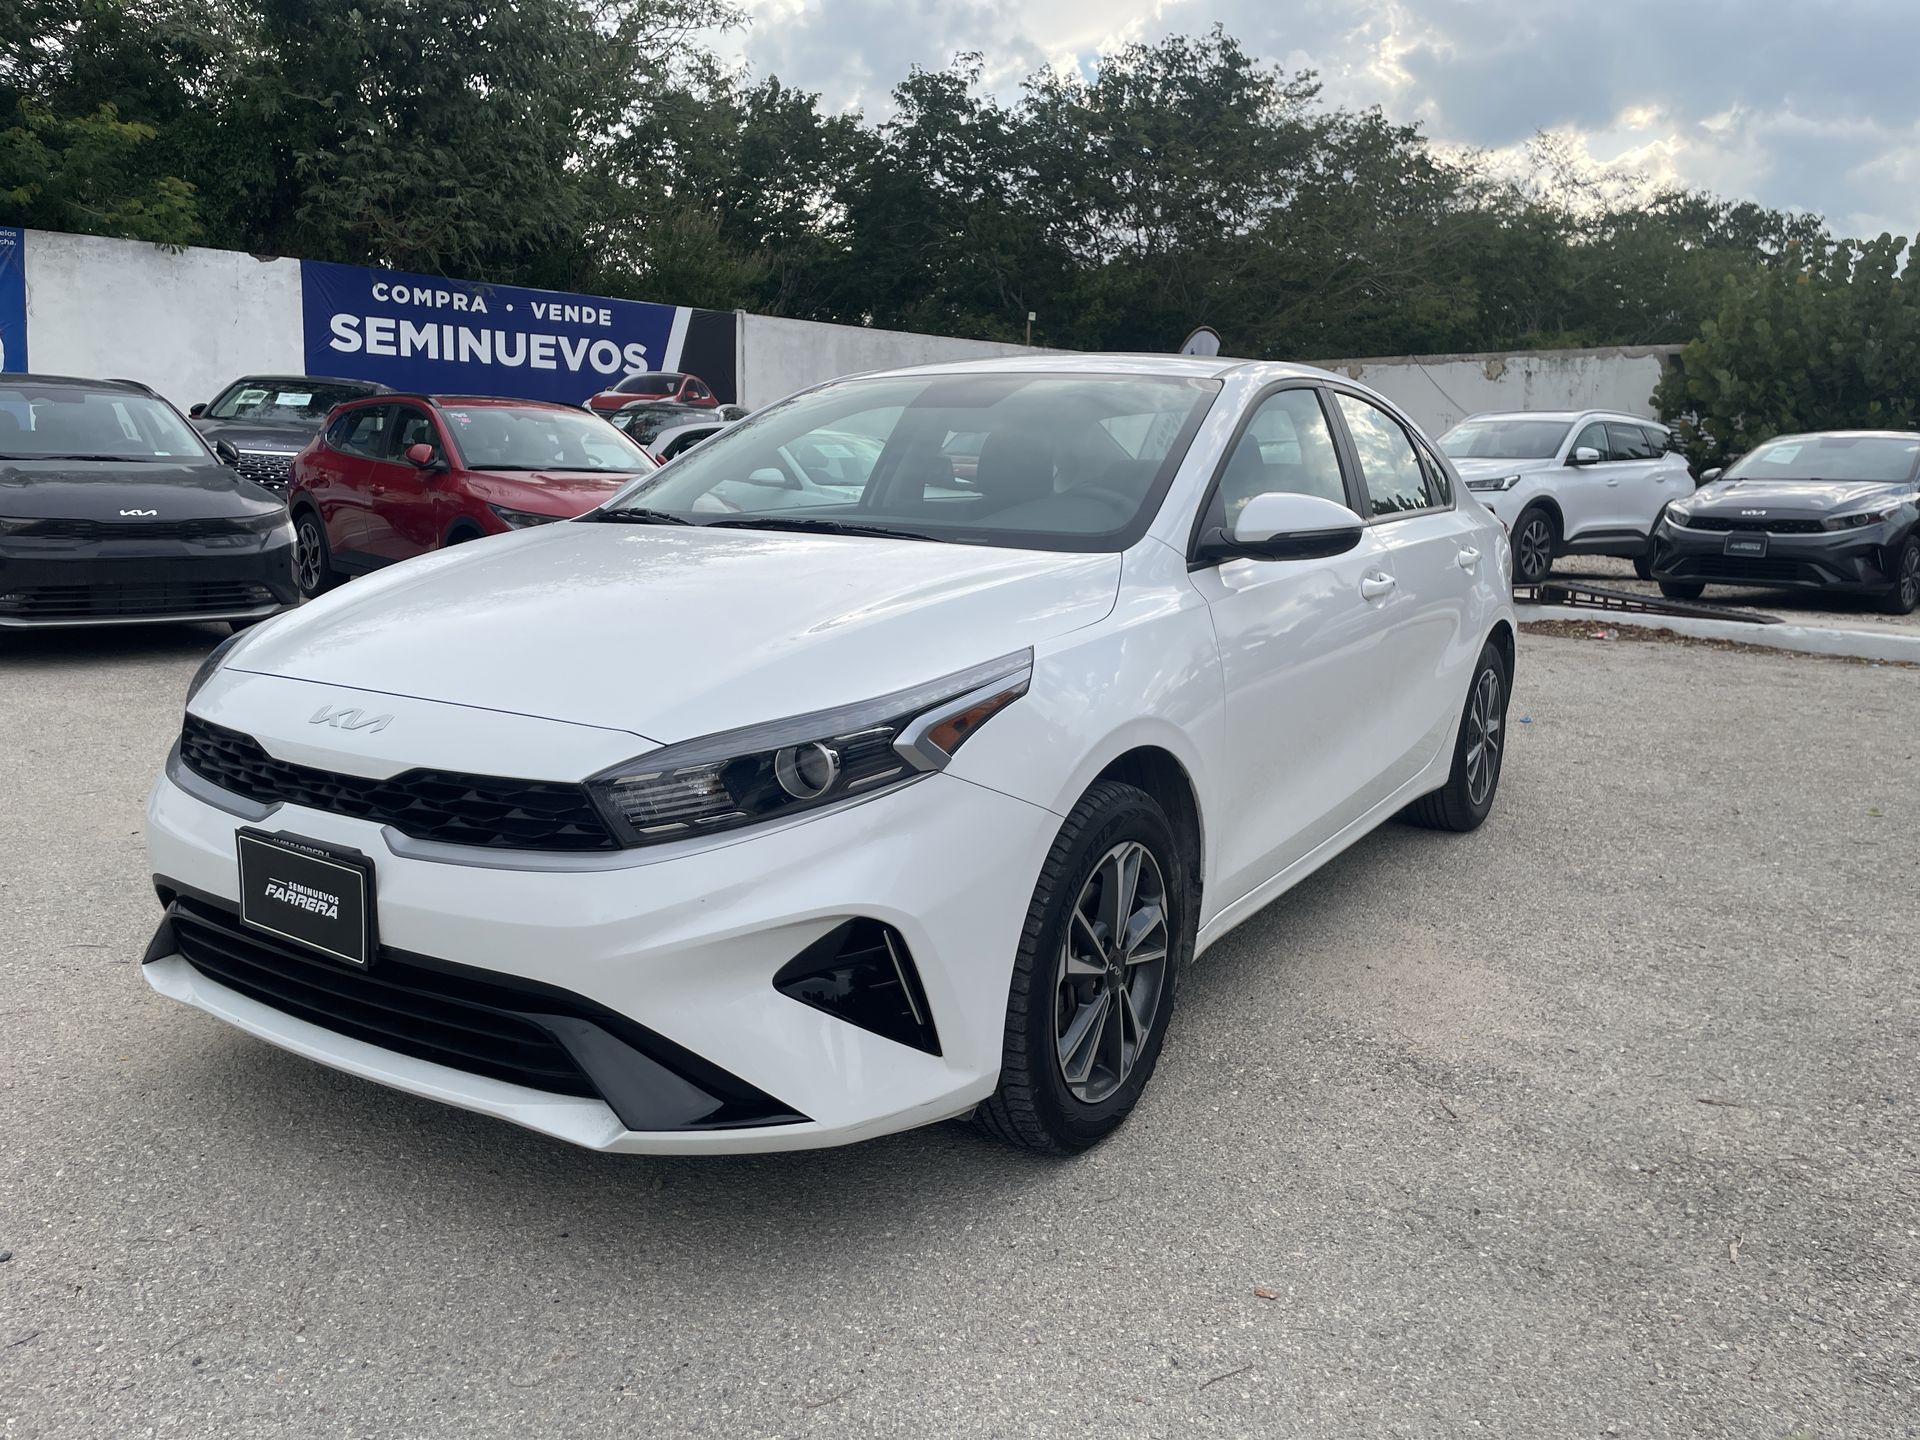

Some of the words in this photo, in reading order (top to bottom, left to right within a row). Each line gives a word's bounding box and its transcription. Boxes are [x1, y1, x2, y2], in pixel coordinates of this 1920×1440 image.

[371, 282, 488, 314] COMPRA
[531, 302, 612, 327] VENDE
[329, 313, 649, 375] SEMINUEVOS
[119, 509, 158, 517] KIA
[308, 704, 395, 734] KIA
[264, 883, 338, 920] FARRERA
[288, 881, 340, 905] SEMINUEVOS
